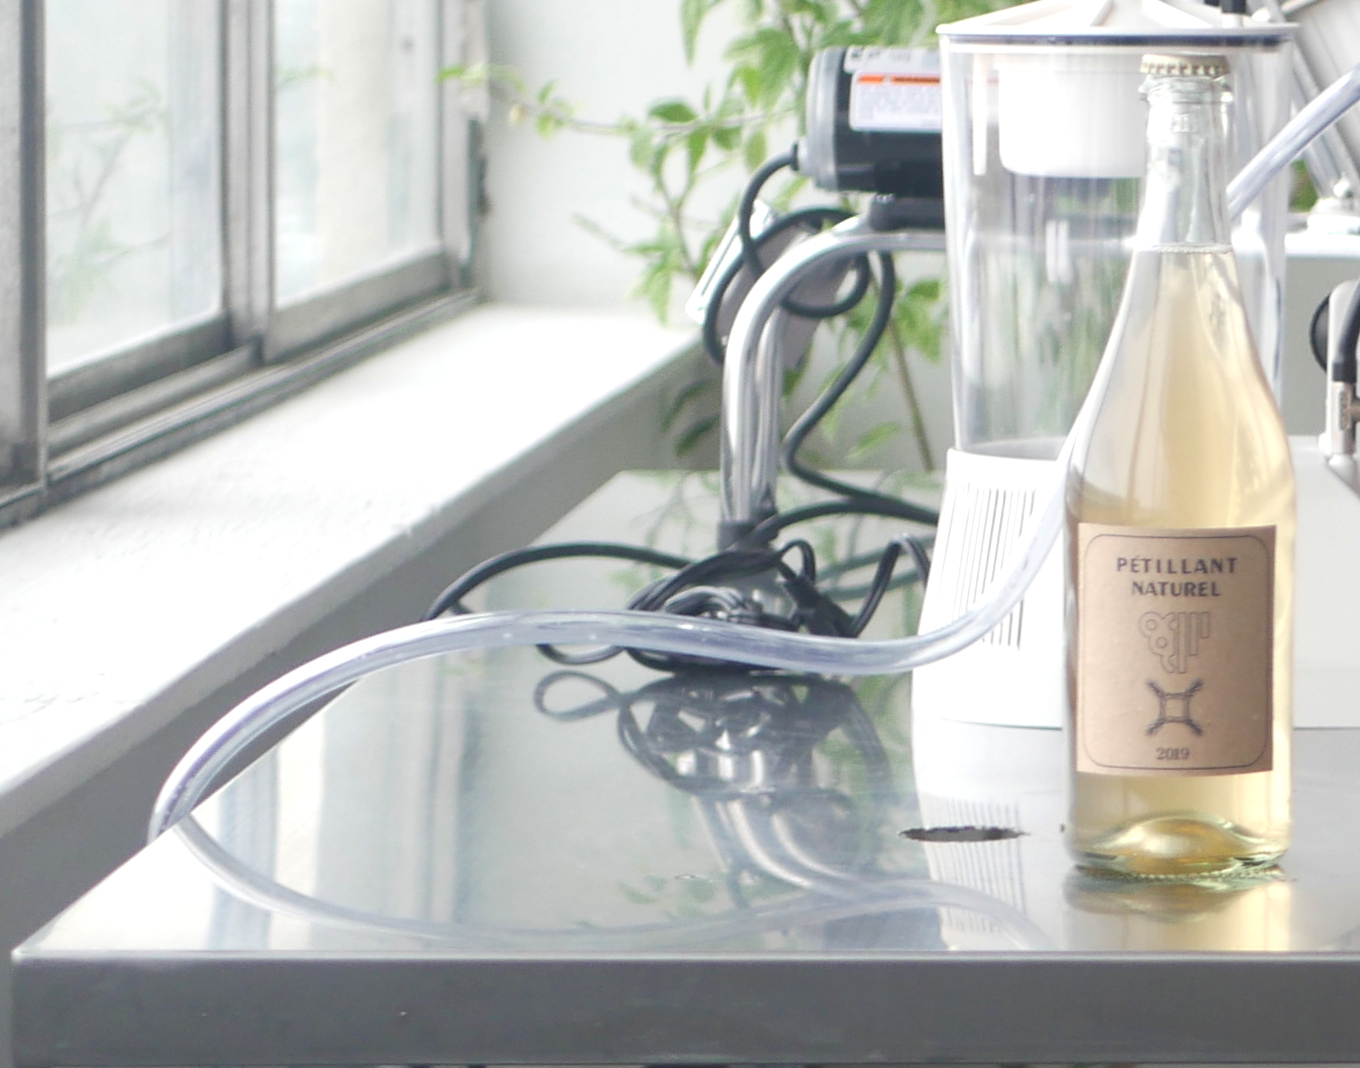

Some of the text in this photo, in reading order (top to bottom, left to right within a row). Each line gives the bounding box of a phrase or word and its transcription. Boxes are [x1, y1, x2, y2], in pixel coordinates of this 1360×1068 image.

[1116, 554, 1238, 574] PÉTILLANT
[1132, 581, 1221, 597] NATUREL
[1156, 747, 1190, 761] 2019
